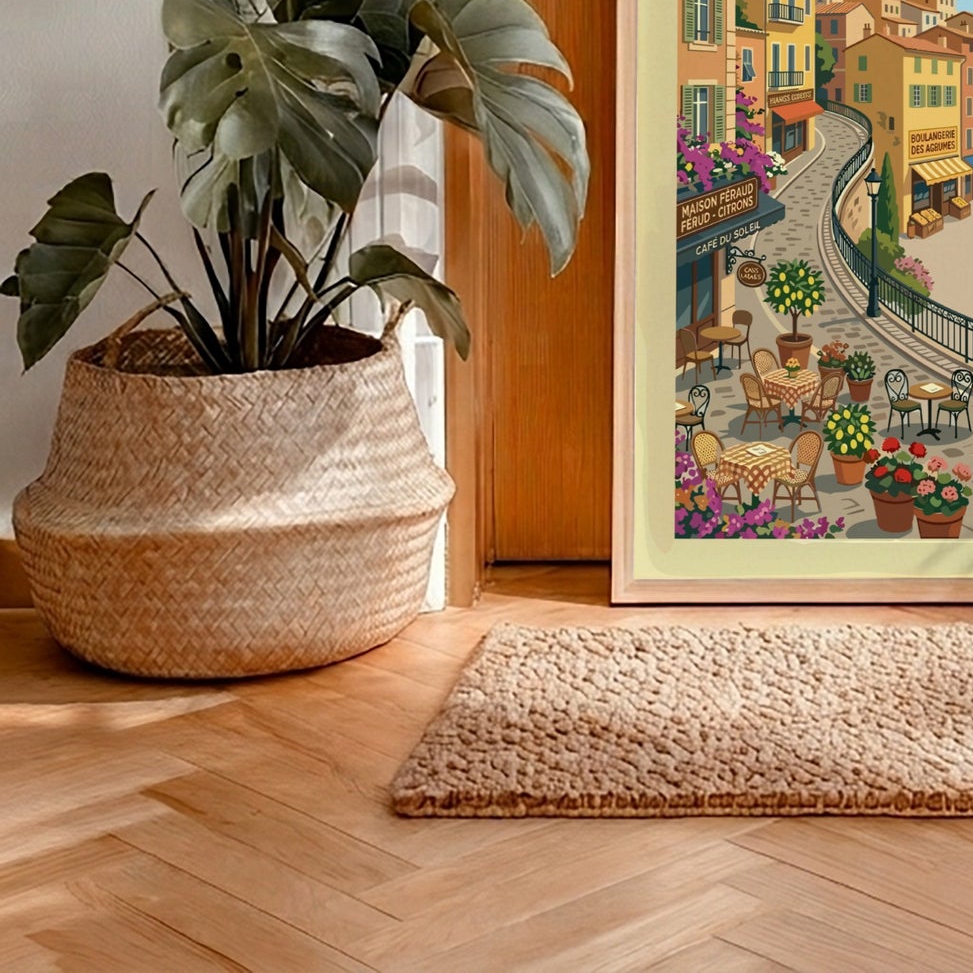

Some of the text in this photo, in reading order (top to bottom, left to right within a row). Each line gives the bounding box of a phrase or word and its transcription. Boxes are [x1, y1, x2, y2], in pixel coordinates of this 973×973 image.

[911, 130, 955, 143] BOULANGERIE
[911, 145, 924, 155] DES
[681, 183, 754, 218] MAISON FÉRAUD
[717, 195, 754, 218] CITRONS
[695, 221, 761, 255] CAFÉ DU SOLEIL
